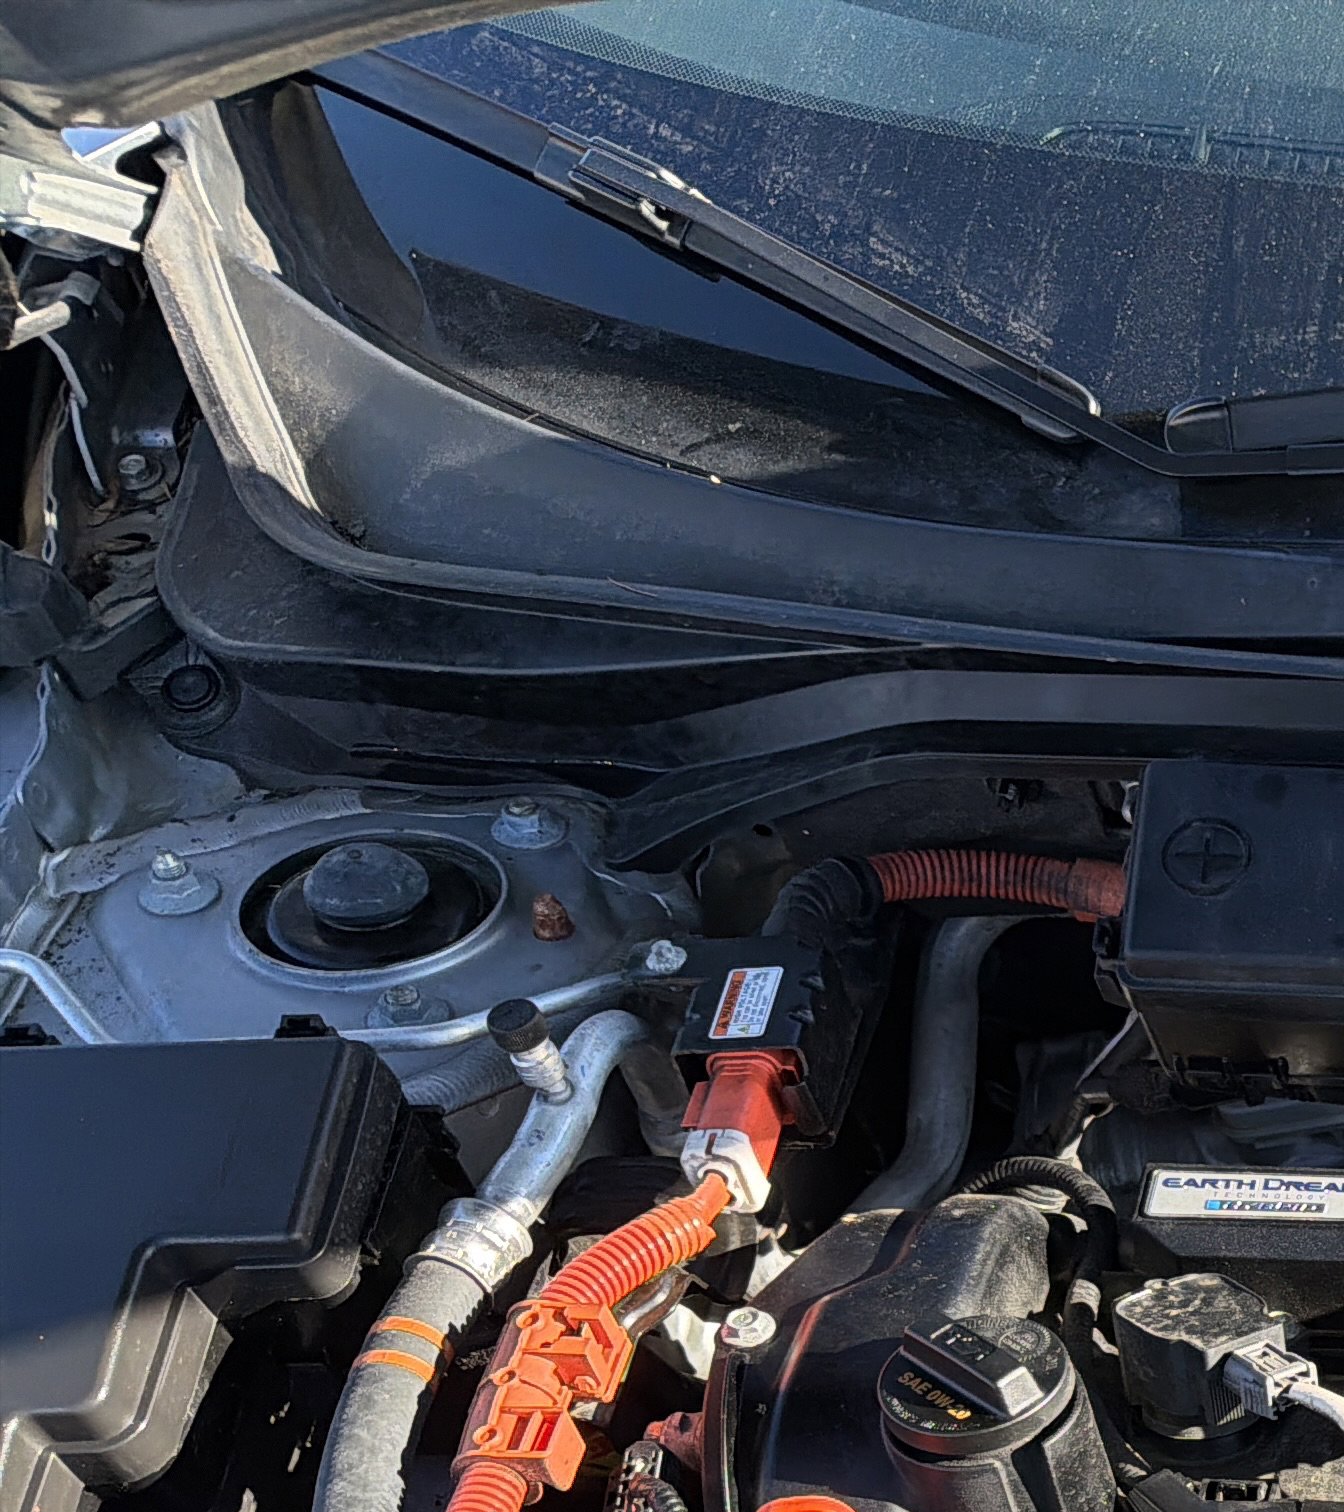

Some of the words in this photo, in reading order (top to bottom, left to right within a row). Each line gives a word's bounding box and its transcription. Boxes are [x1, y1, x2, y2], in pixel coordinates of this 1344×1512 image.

[1161, 1177, 1257, 1190] EARTH
[1213, 1191, 1326, 1201] TECHNOLOGY
[898, 1371, 933, 1395] SAE
[926, 1387, 972, 1421] 0W-20
